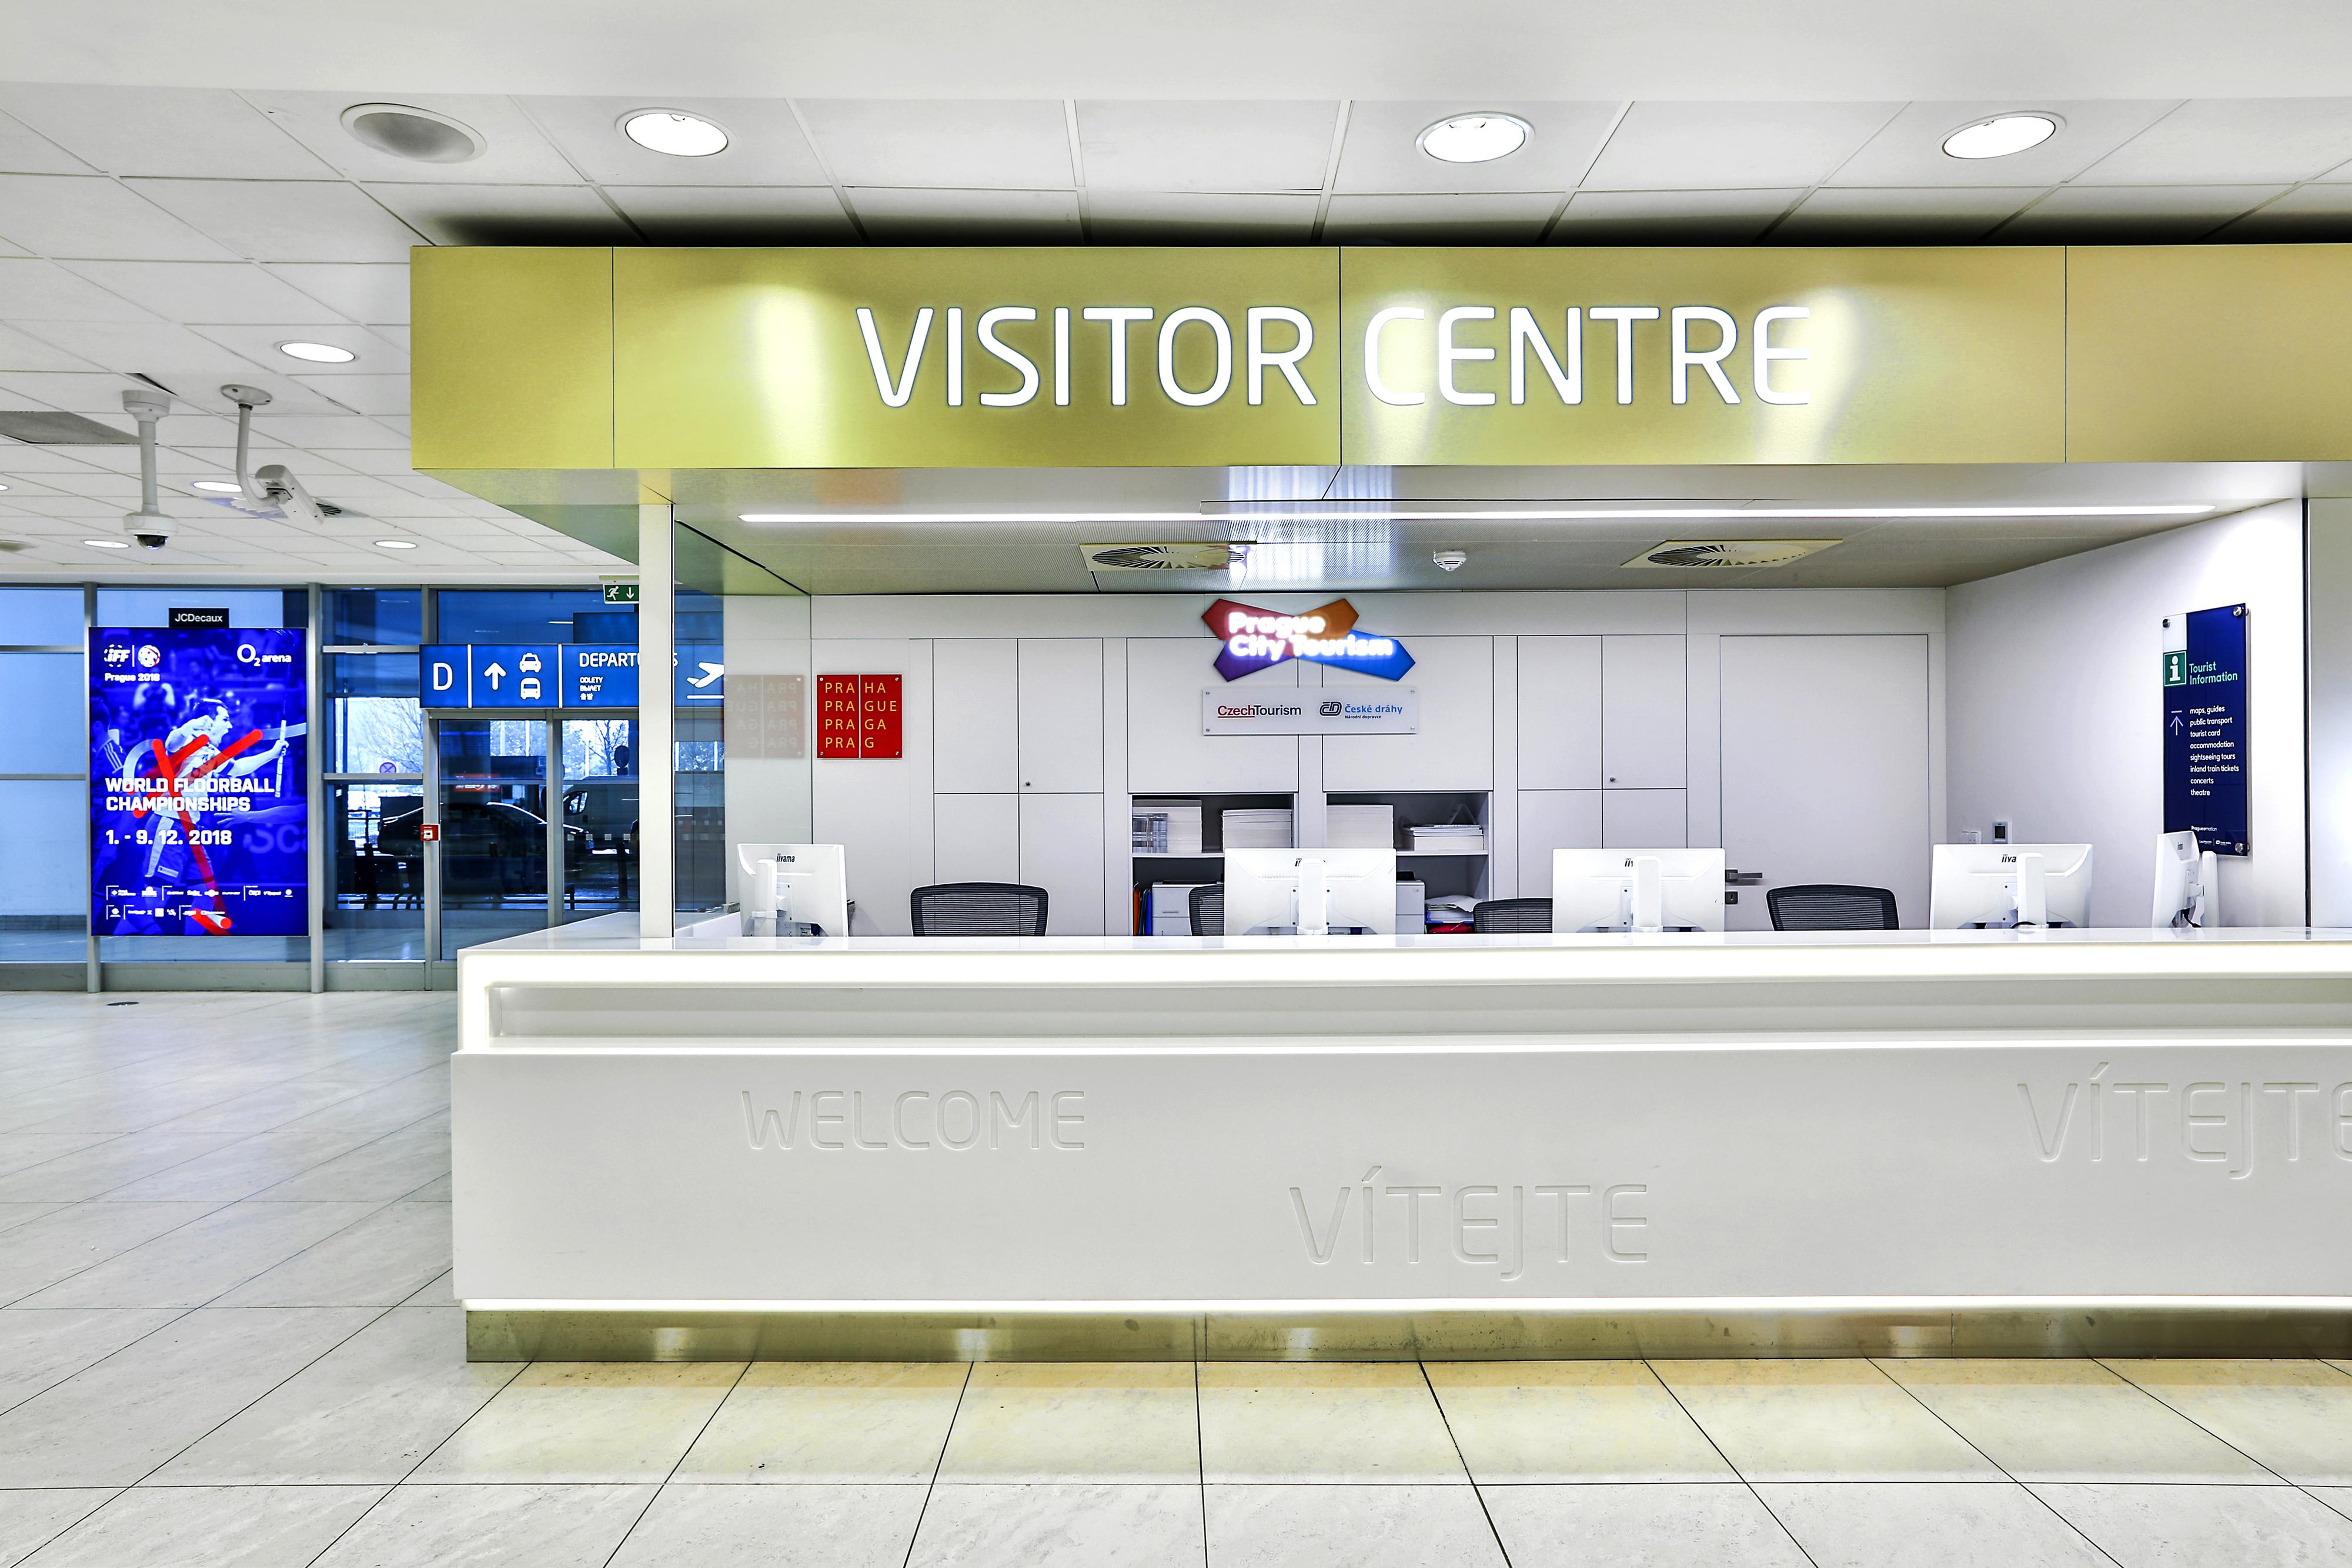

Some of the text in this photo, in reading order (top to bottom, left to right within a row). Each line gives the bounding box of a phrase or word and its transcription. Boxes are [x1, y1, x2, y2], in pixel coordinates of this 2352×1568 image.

[856, 306, 1810, 407] VISITOR CENTRE
[175, 613, 223, 623] JCDecaux
[1228, 612, 1325, 638] Prague
[1229, 633, 1394, 661] City Tourism
[262, 653, 292, 663] arena
[2189, 661, 2216, 674] Tourist
[105, 673, 161, 683] Prague 2018
[433, 662, 453, 691] D
[2190, 671, 2238, 685] Information
[1217, 704, 1302, 716] CzechTourism
[1345, 704, 1403, 715] České dráhy
[2207, 706, 2226, 715] guides
[2190, 717, 2233, 728] public transport
[2190, 741, 2234, 749] accommodation
[2190, 753, 2220, 763] sightseeing
[105, 778, 275, 793] WORLD FLOORBALL
[106, 797, 251, 811] CHAMPIONSHIPS
[105, 830, 119, 845] 1.
[136, 830, 153, 845] 9.
[158, 830, 183, 845] 12.
[188, 830, 232, 845] 2018
[776, 853, 795, 862] iiyama
[2002, 854, 2017, 862] iiya
[741, 1091, 1085, 1150] WELCOME
[1289, 1165, 1648, 1281] VÍTEJTE
